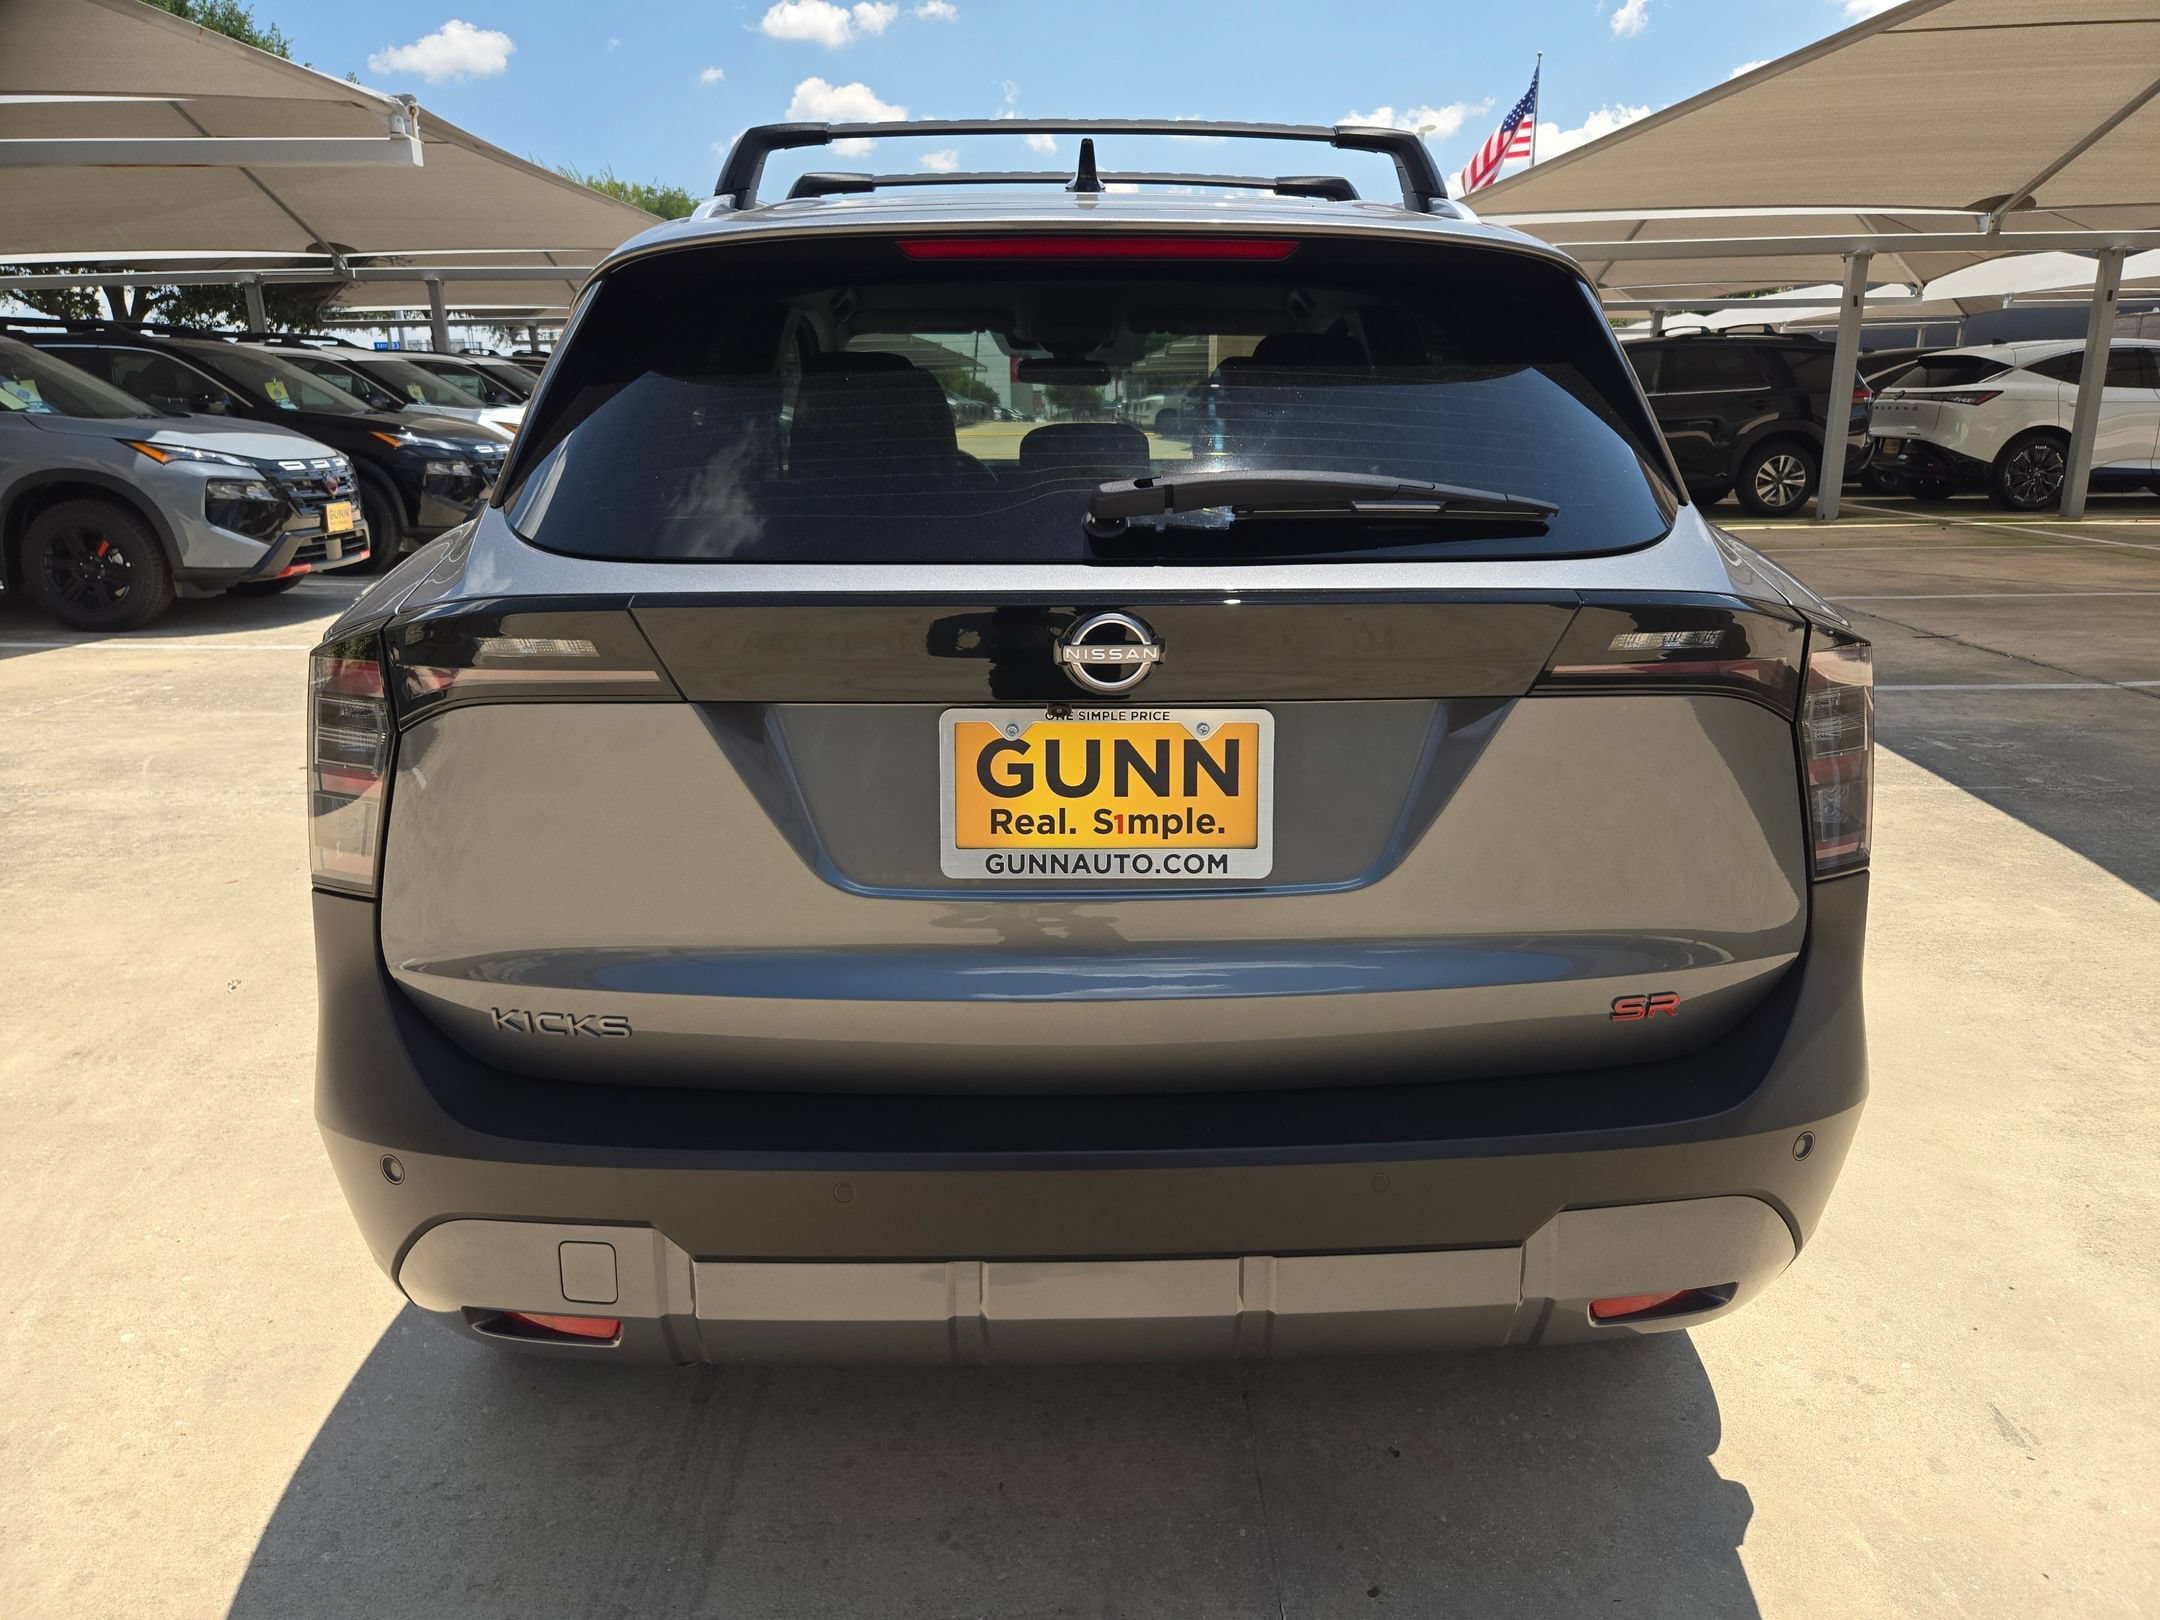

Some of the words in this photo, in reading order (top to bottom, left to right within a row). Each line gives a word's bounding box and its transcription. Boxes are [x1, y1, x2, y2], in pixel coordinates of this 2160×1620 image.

[1066, 647, 1158, 660] NISSAN
[1078, 711, 1126, 721] SIMPLE
[1130, 711, 1170, 721] PRICE
[976, 737, 1240, 798] GUNN
[990, 807, 1077, 835] Real.
[985, 853, 1228, 875] GUNNAUTO.COM
[1609, 991, 1681, 1022] SR
[491, 1006, 632, 1039] KICKS
